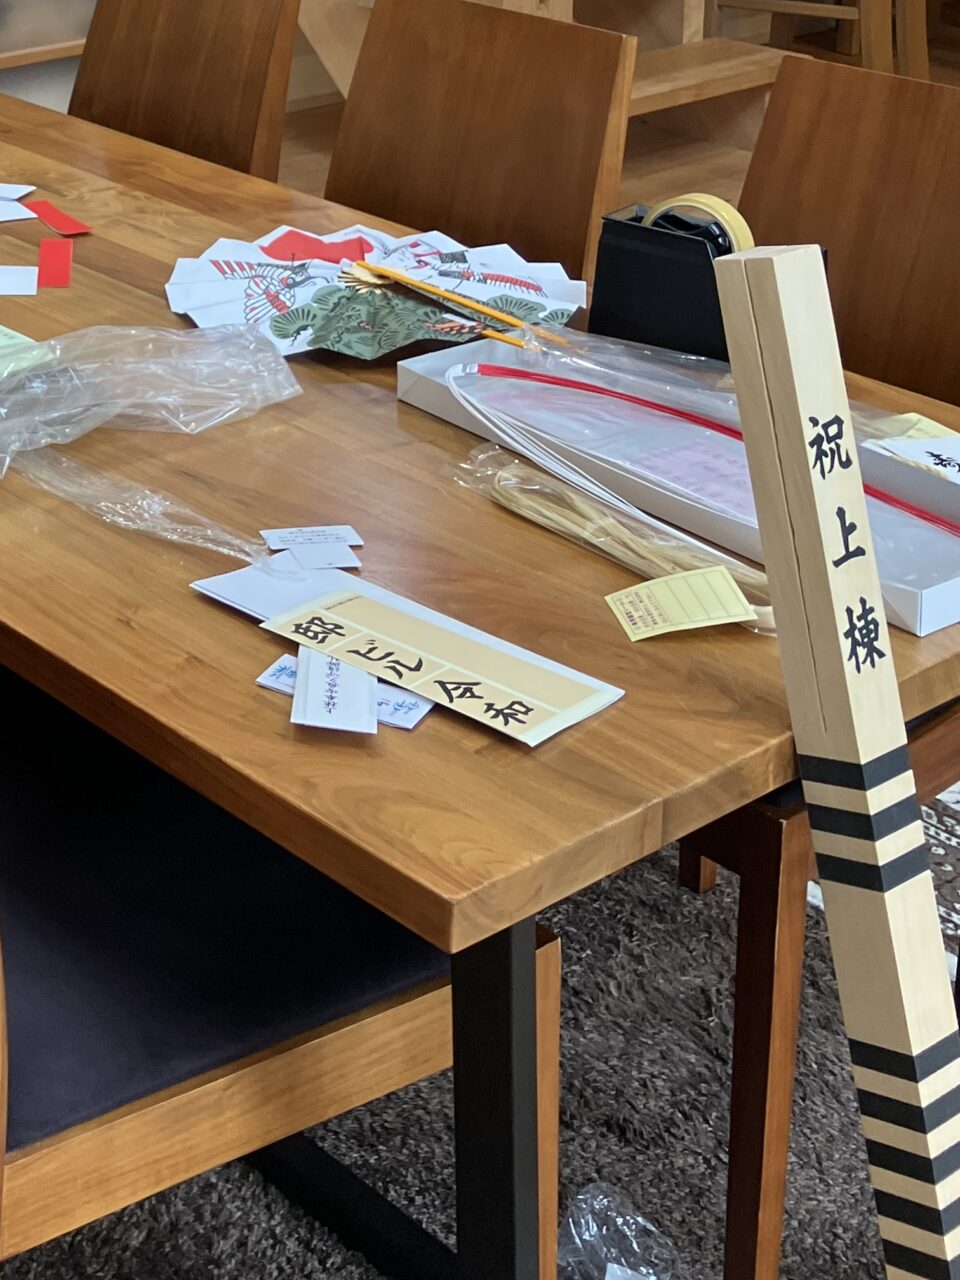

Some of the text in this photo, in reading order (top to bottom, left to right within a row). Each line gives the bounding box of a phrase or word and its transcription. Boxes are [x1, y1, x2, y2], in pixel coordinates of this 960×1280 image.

[807, 414, 886, 675] 祝上棟
[291, 616, 352, 645] 邸
[348, 639, 424, 680] ビル
[433, 679, 535, 727] 令和
